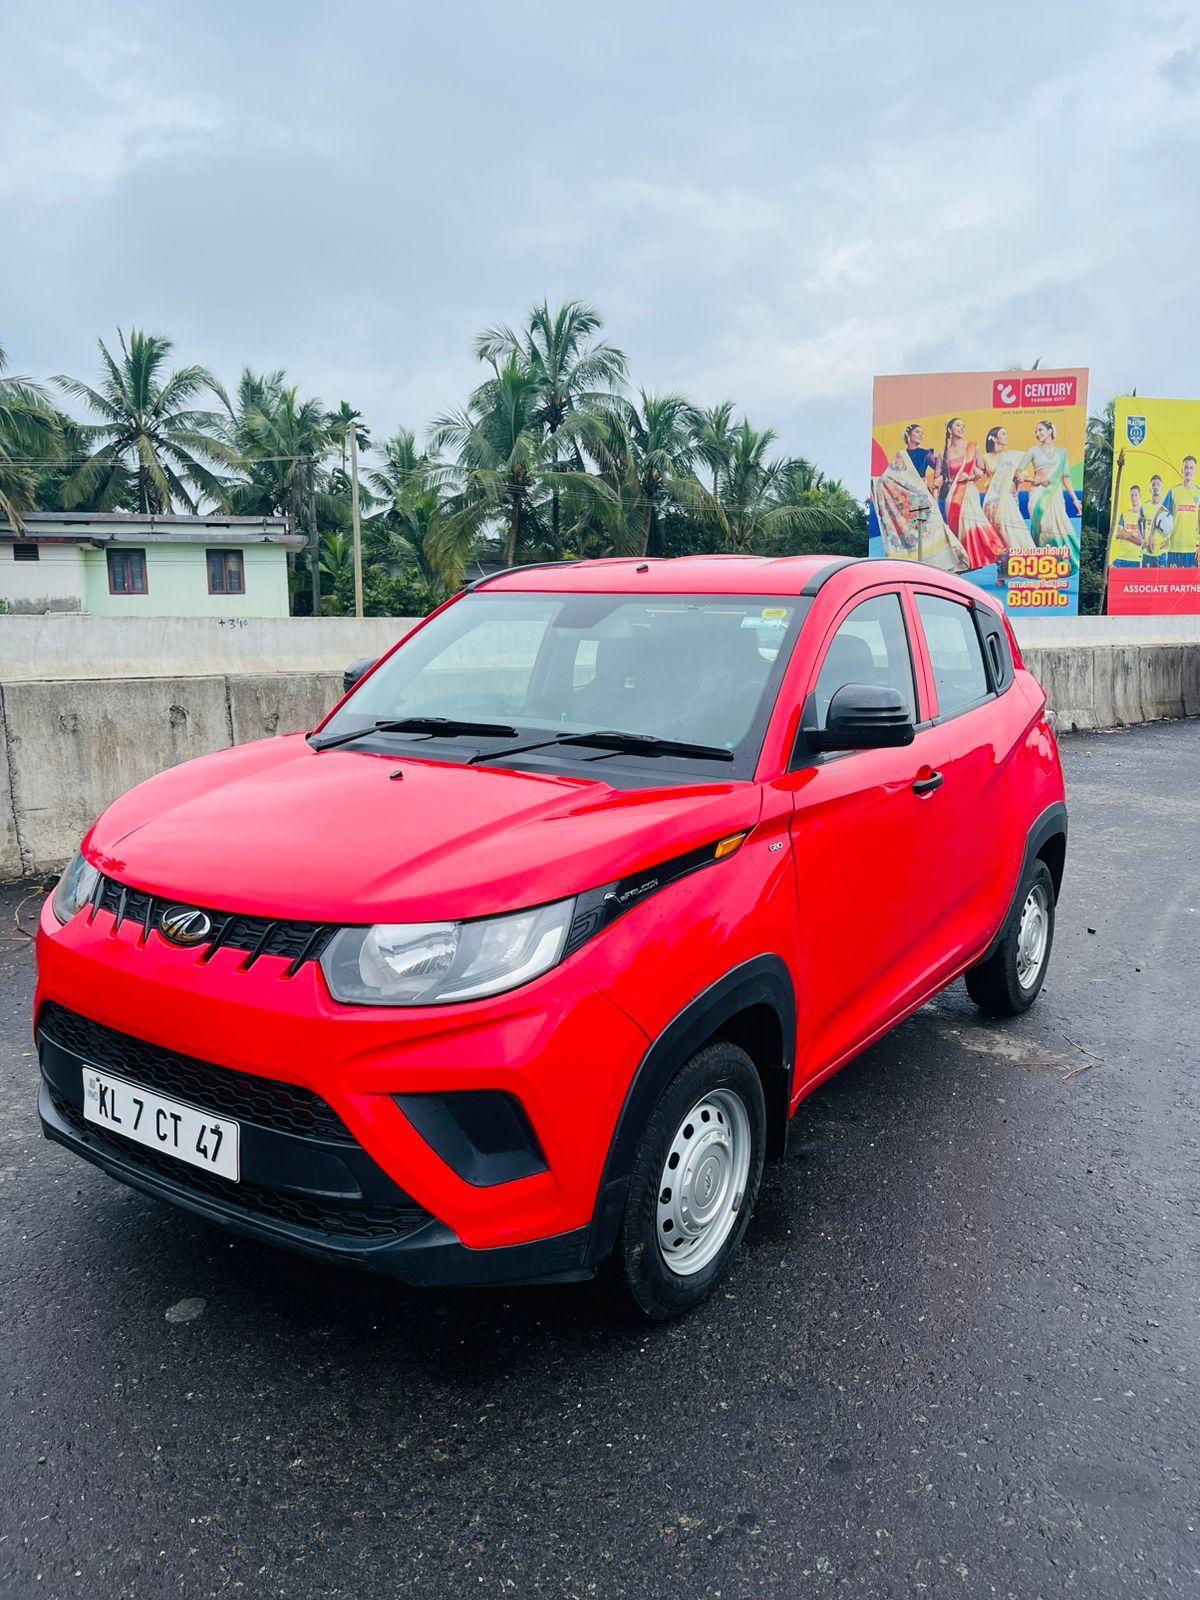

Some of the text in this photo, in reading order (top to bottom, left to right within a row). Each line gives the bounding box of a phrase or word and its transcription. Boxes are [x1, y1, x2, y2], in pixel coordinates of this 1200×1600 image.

[1024, 382, 1073, 397] CENTURY
[1008, 556, 1070, 579] ഓളം
[1123, 584, 1169, 593] ASSOCIATE
[1008, 590, 1069, 607] ഓണം
[99, 1083, 223, 1163] KL 7 CT 47
